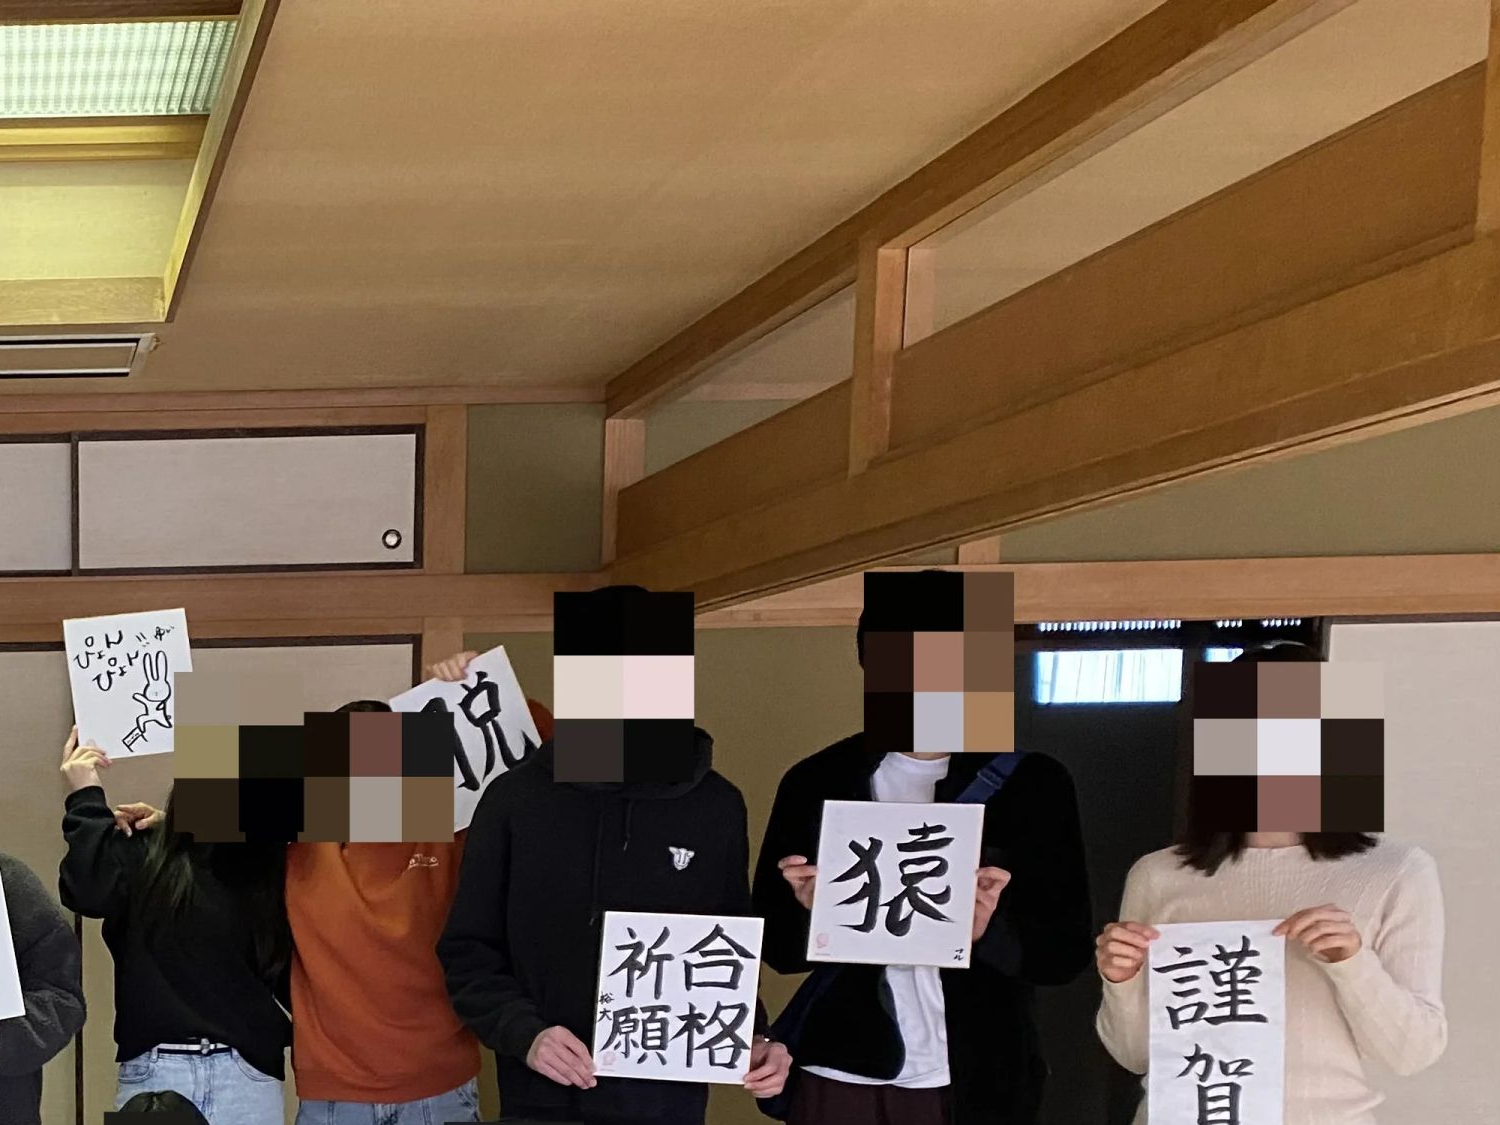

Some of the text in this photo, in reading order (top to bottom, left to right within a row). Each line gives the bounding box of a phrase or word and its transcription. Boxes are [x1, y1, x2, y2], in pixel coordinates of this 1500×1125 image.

[828, 822, 956, 937] 猿
[600, 926, 675, 1066] 祈願
[669, 923, 757, 1069] 合格
